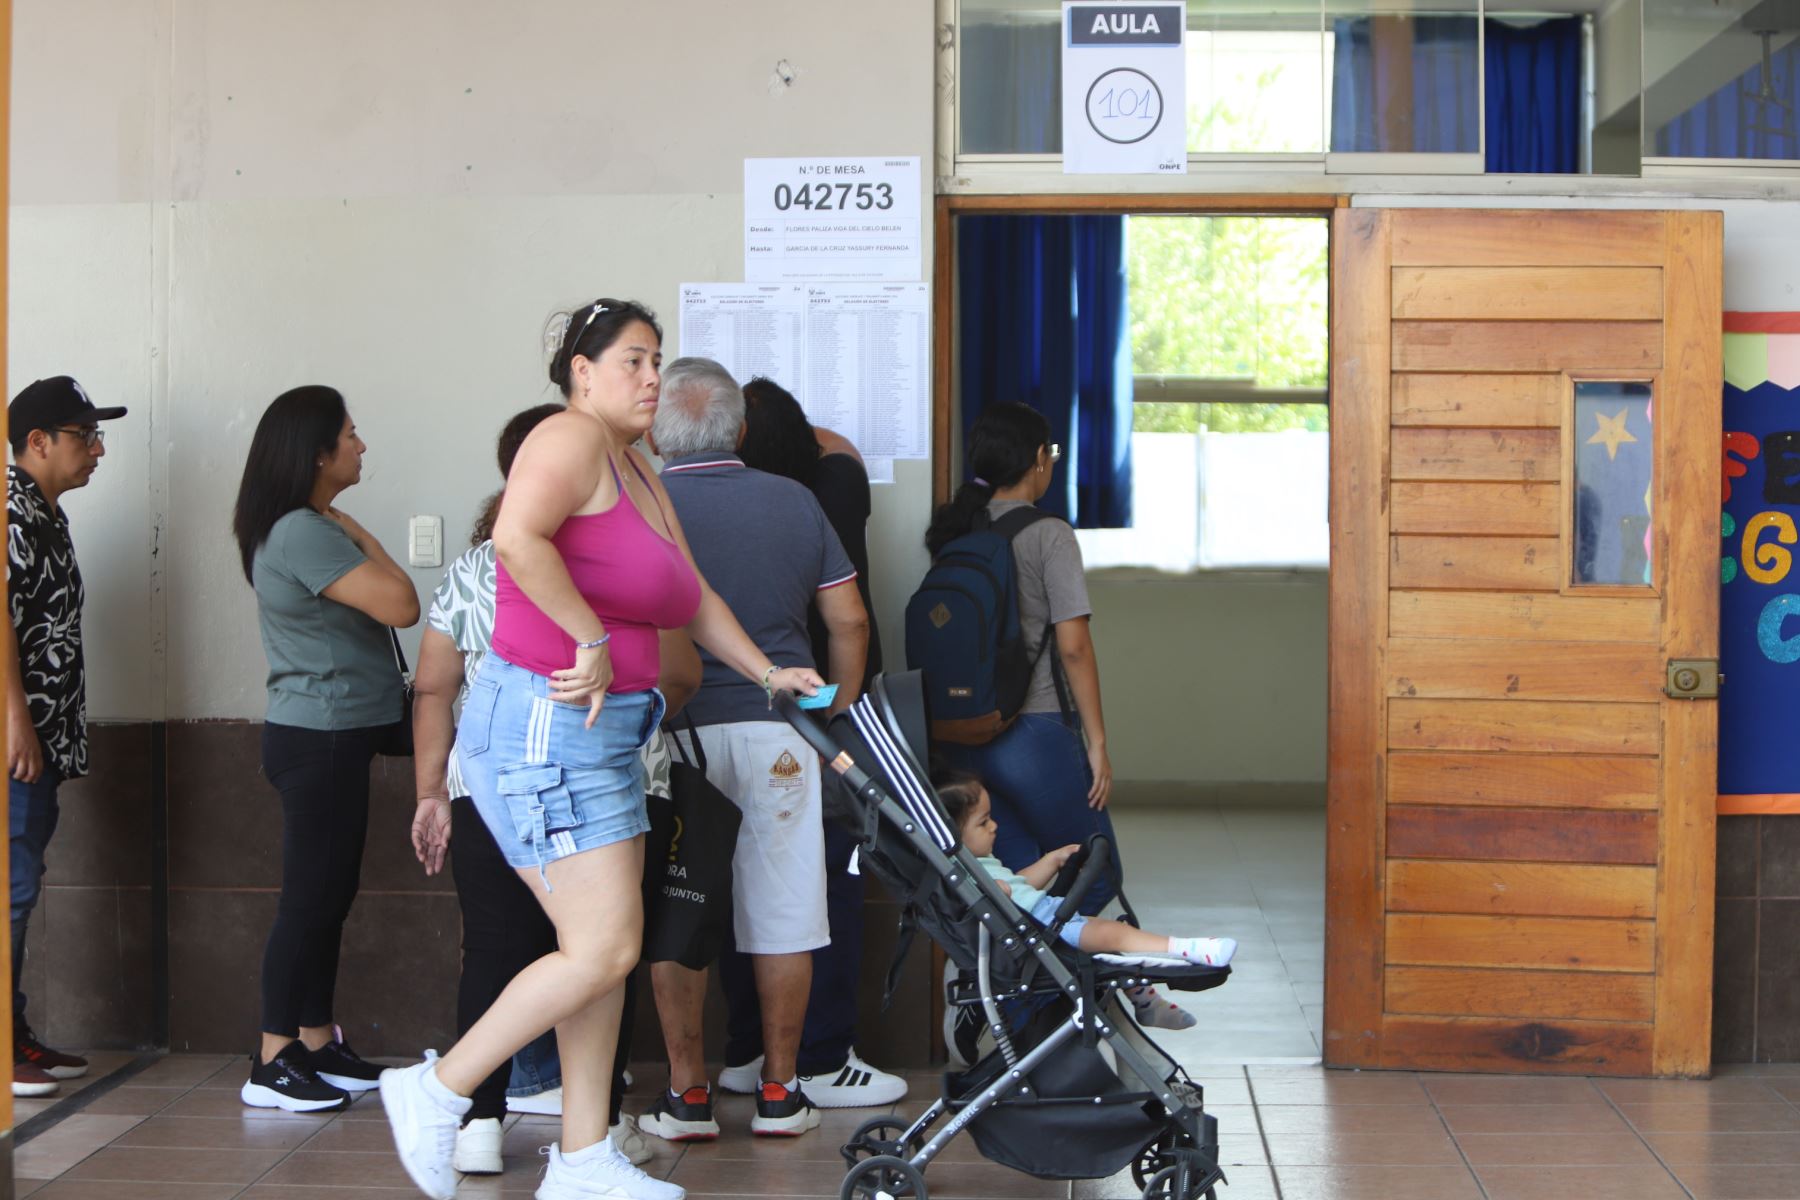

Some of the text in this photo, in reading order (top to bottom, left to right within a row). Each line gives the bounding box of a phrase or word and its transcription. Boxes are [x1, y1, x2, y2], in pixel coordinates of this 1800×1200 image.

[1091, 13, 1160, 34] AULA
[1098, 88, 1154, 119] 101
[816, 165, 831, 174] DE
[834, 165, 866, 174] MESA
[774, 182, 894, 211] 042753
[668, 886, 706, 904] JUNTOS
